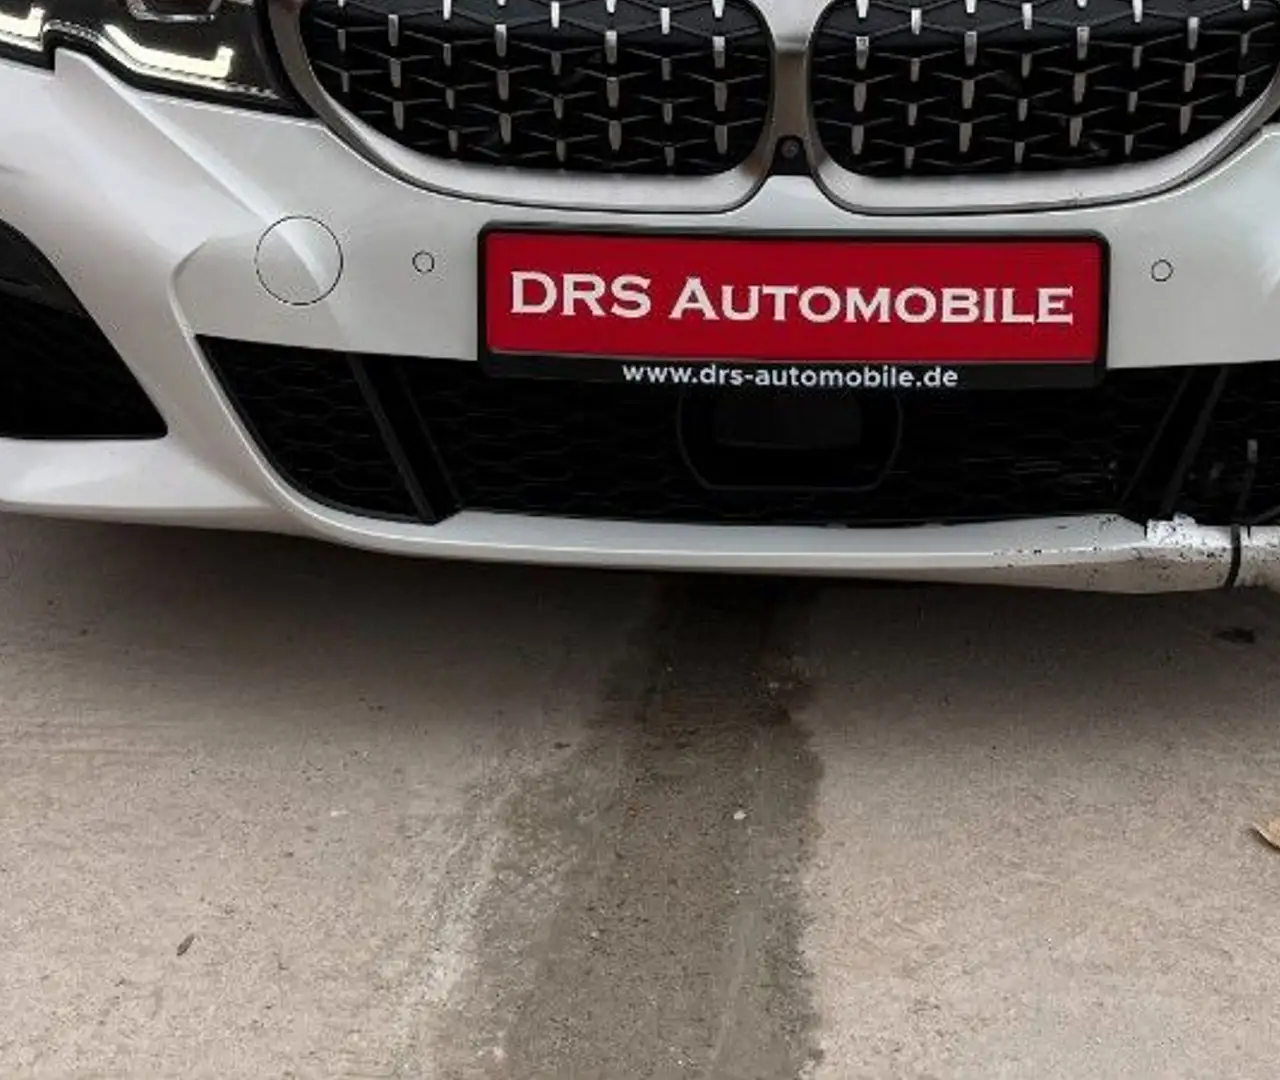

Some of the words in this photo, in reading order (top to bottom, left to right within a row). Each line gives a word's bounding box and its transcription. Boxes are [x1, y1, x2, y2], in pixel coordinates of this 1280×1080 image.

[510, 271, 652, 319] DRS
[670, 276, 1074, 325] AUTOMOBILE
[622, 363, 959, 388] www.drs-automobile.de
